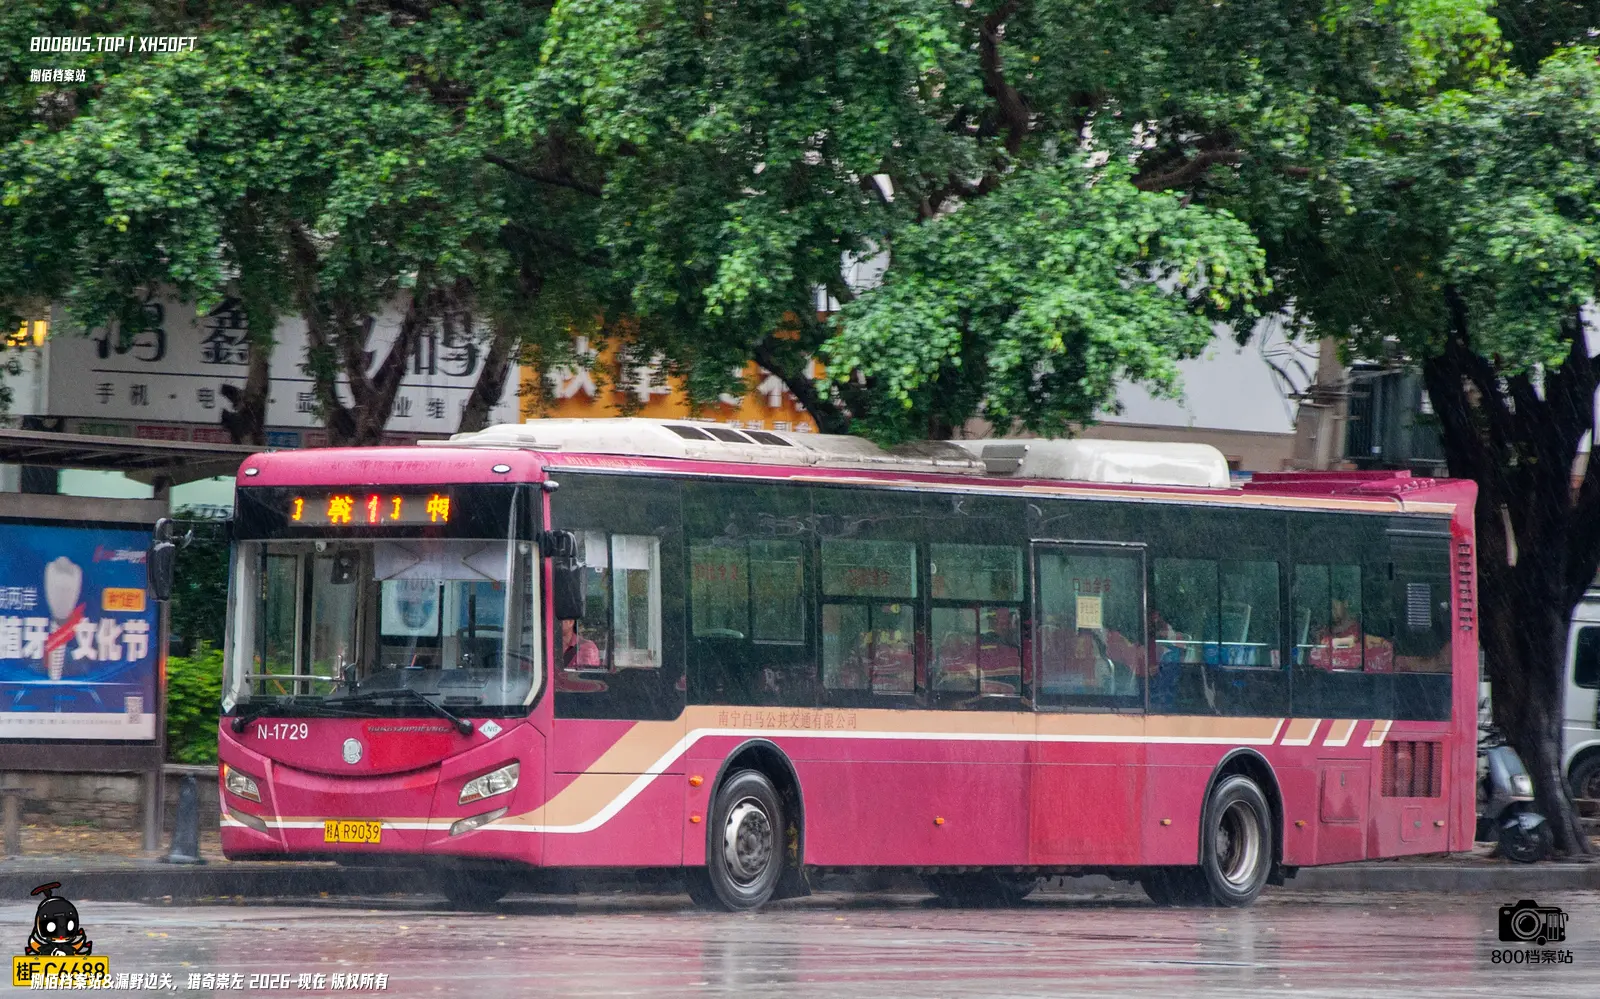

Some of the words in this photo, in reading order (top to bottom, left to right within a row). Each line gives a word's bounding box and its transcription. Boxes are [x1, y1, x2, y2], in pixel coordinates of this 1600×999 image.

[71, 616, 150, 662] 文化节
[483, 725, 498, 733] LNG
[717, 709, 859, 731] 南宁白马公共交通有限公司
[257, 723, 308, 740] N-1729
